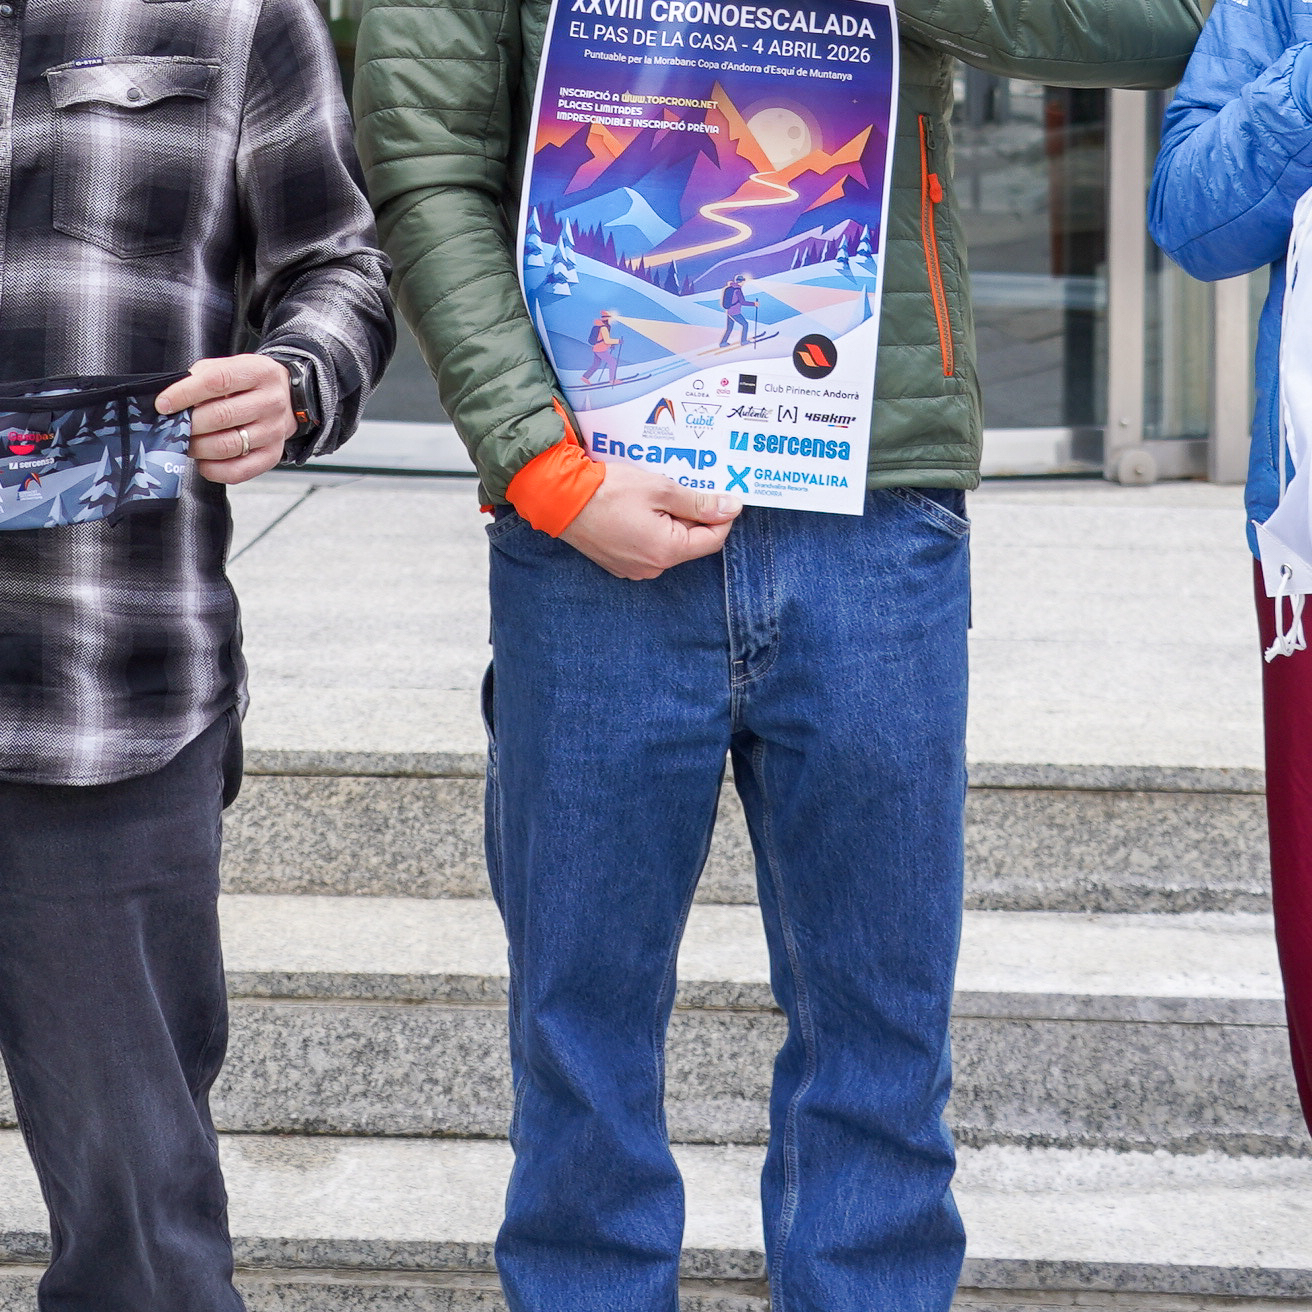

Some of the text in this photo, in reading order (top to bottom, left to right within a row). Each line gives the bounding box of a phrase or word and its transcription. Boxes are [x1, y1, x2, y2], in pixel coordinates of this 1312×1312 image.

[650, 0, 876, 39] CRONOESCALADA
[569, 21, 871, 63] EL PAS DE LA CASA 4 ABRIL 2026
[584, 49, 626, 63] Puntuable
[628, 56, 643, 65] per
[644, 55, 652, 64] la
[653, 56, 696, 67] Morabanc
[697, 59, 719, 70] Copa
[721, 61, 762, 73] d'Andorra
[796, 68, 807, 77] de
[809, 69, 853, 81] Muntanya
[560, 87, 611, 101] INSCRIPCIÓ
[558, 99, 643, 115] PLACES LIMITADES
[556, 111, 631, 127] IMPRESCINDIBLE
[764, 383, 784, 394] Club
[592, 431, 717, 470] Encamp
[753, 433, 851, 460] sercensa
[678, 476, 715, 489] Casa
[754, 468, 848, 488] GRANDVALIRA
